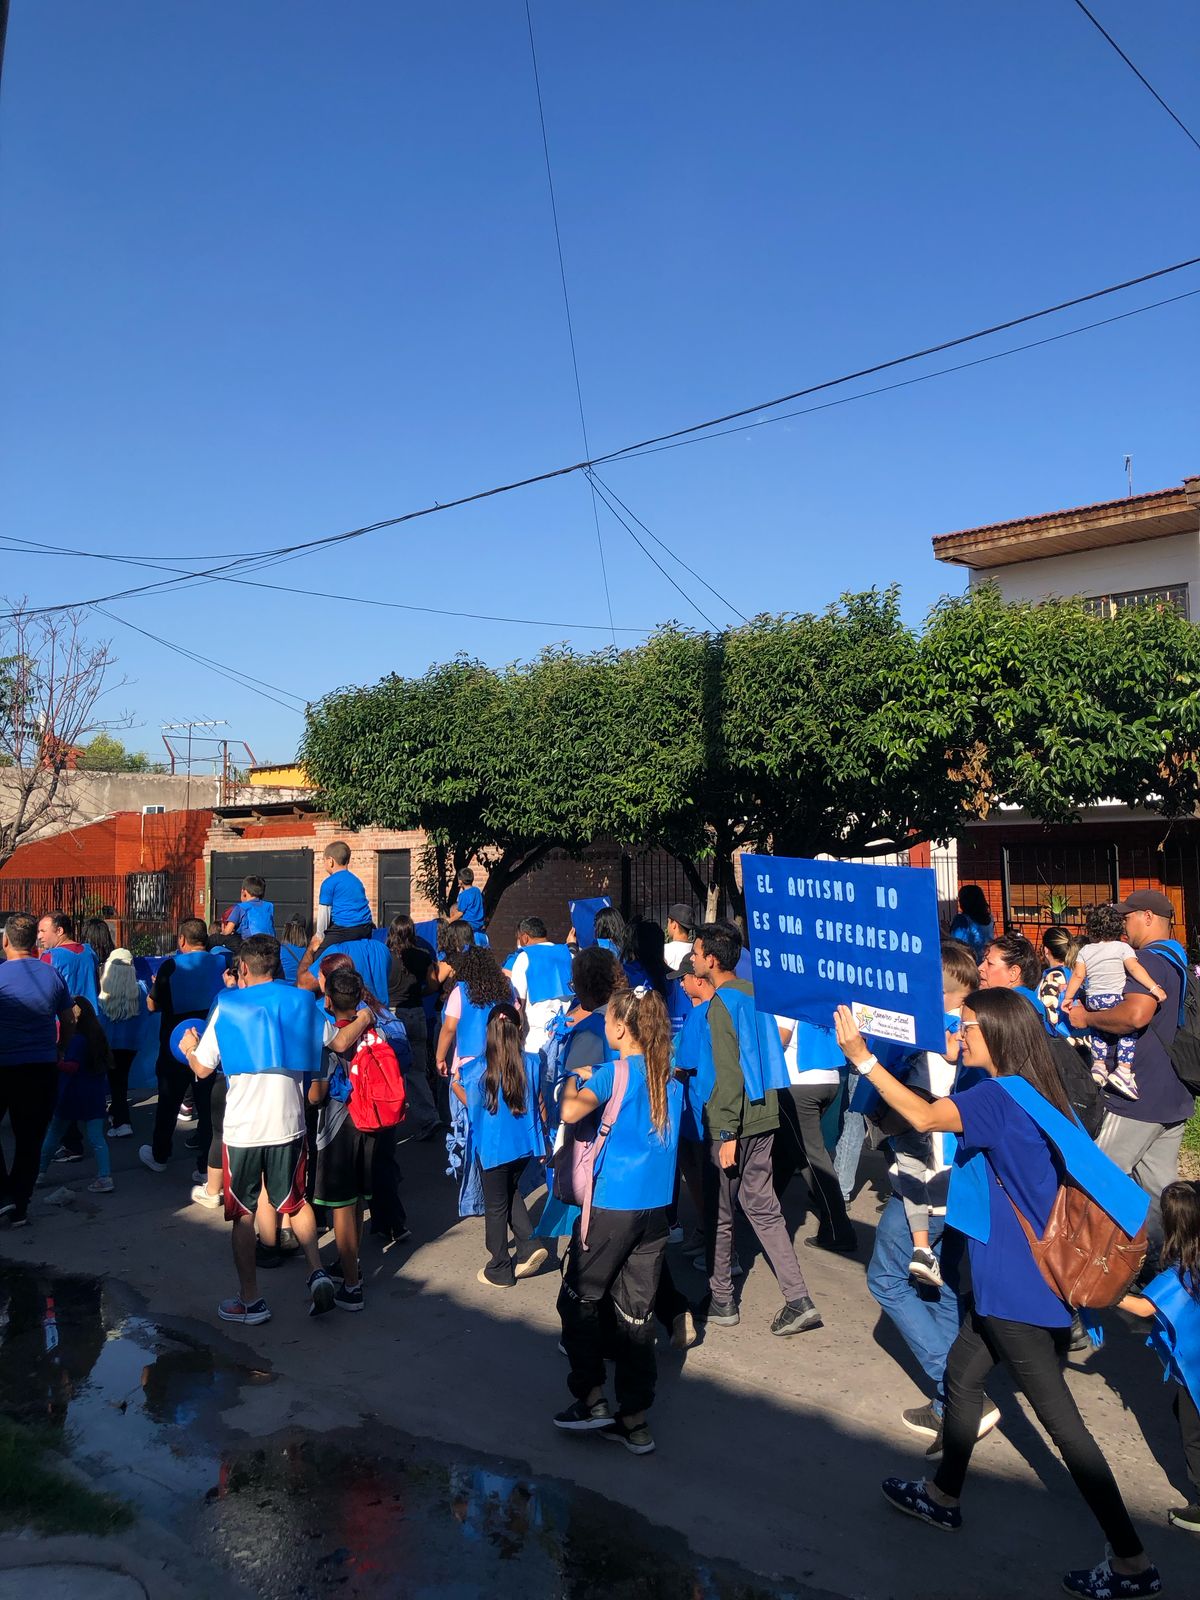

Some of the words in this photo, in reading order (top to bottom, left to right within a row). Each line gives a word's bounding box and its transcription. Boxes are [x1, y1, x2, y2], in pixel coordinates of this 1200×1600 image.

[757, 875, 774, 894] EL
[788, 877, 855, 902] AUTISMO
[876, 887, 898, 909] NO
[753, 911, 770, 930] ES
[779, 915, 803, 935] UNA
[816, 919, 923, 954] ENFERMEDAD
[755, 948, 771, 968] ES
[781, 954, 805, 974] UNA
[818, 959, 909, 994] CONDICION
